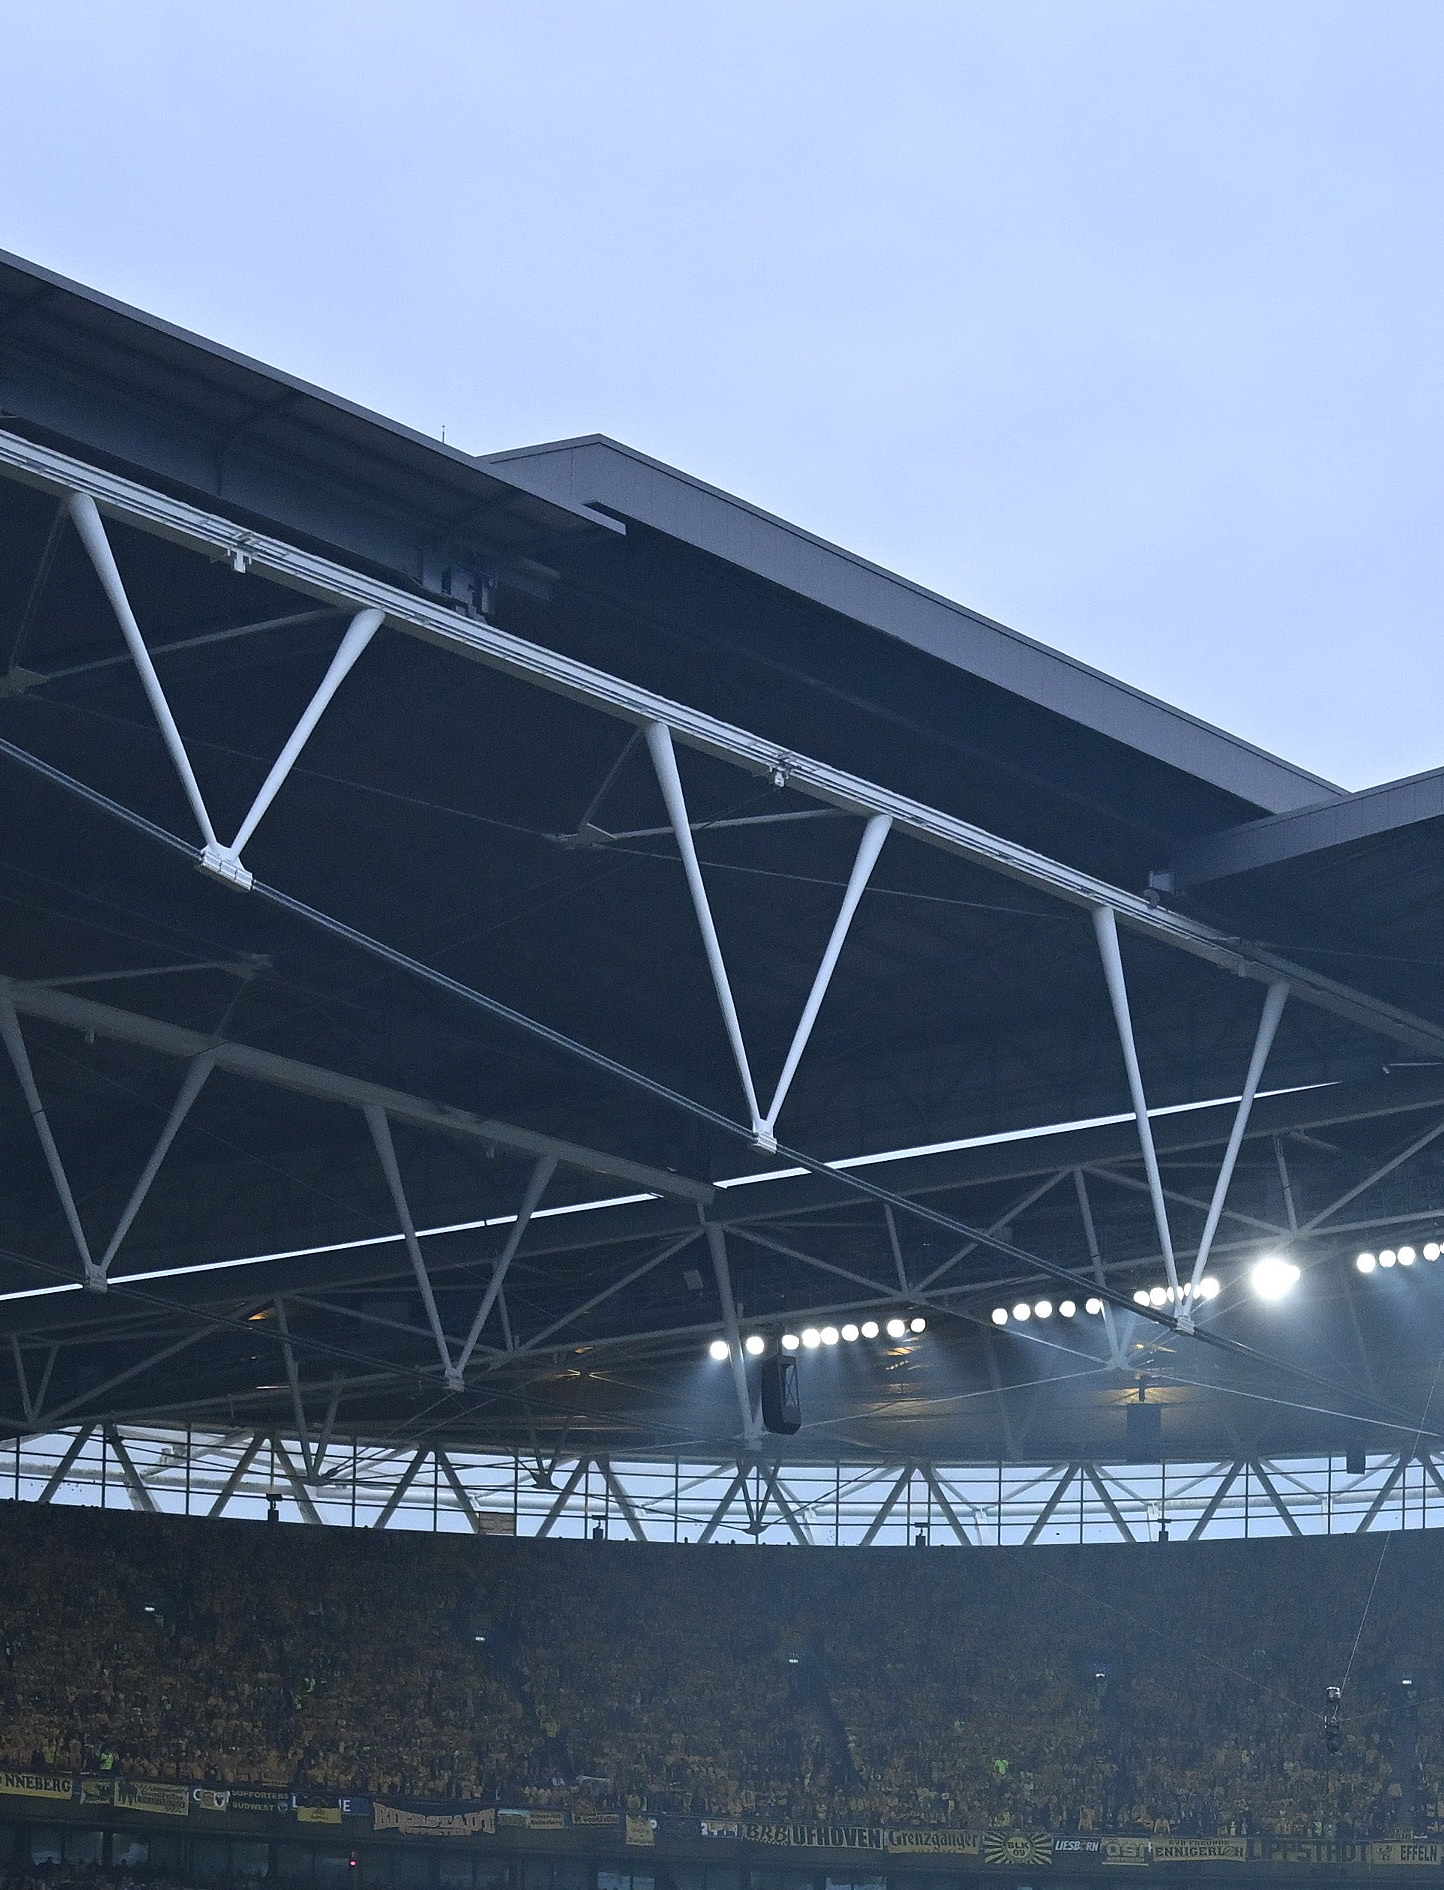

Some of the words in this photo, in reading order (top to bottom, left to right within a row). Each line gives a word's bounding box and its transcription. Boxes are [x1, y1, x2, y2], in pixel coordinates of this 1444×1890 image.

[791, 1825, 883, 1849] UFHOVEN
[1007, 1841, 1029, 1850] BLK
[1055, 1841, 1099, 1852] LIESBRN
[1155, 1845, 1244, 1858] ENNIGERLH
[1400, 1844, 1438, 1862] EFFELN
